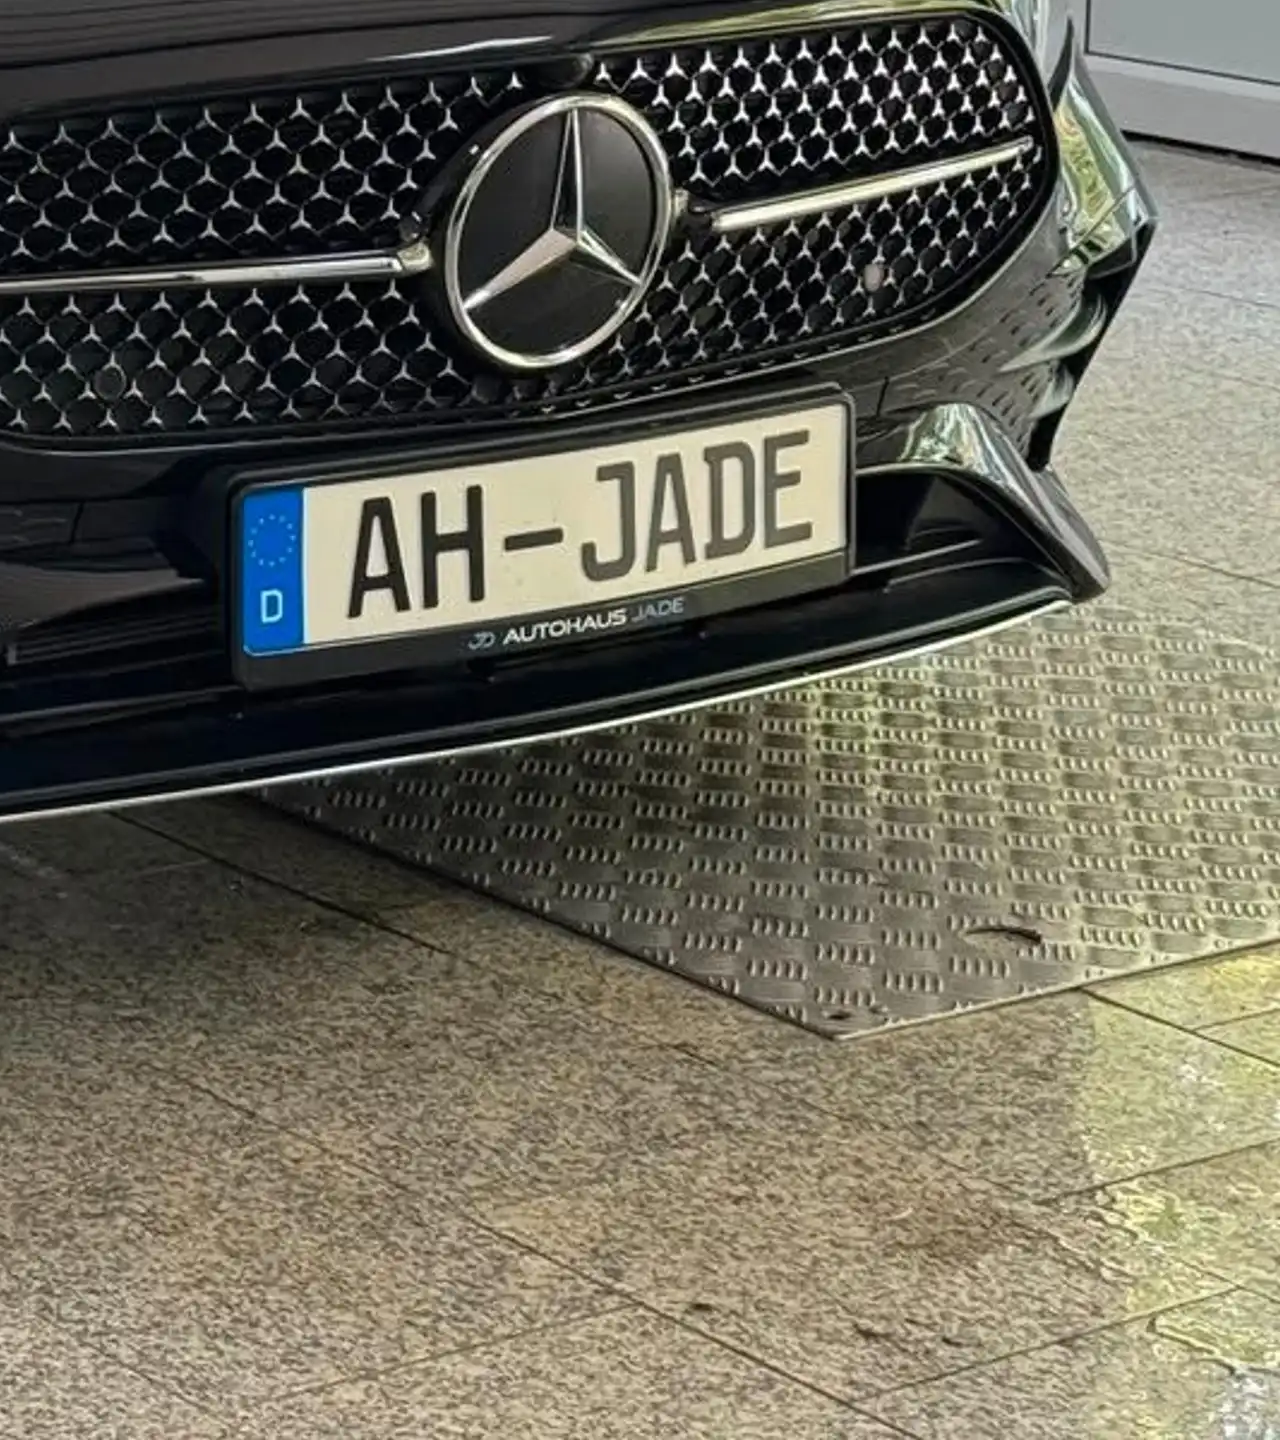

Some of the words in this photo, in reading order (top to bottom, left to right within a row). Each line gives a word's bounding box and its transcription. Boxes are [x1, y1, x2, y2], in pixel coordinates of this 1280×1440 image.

[346, 428, 813, 619] AH-JADE
[260, 589, 284, 625] D
[502, 608, 627, 646] AUTOHAUS
[631, 597, 686, 622] JADE
